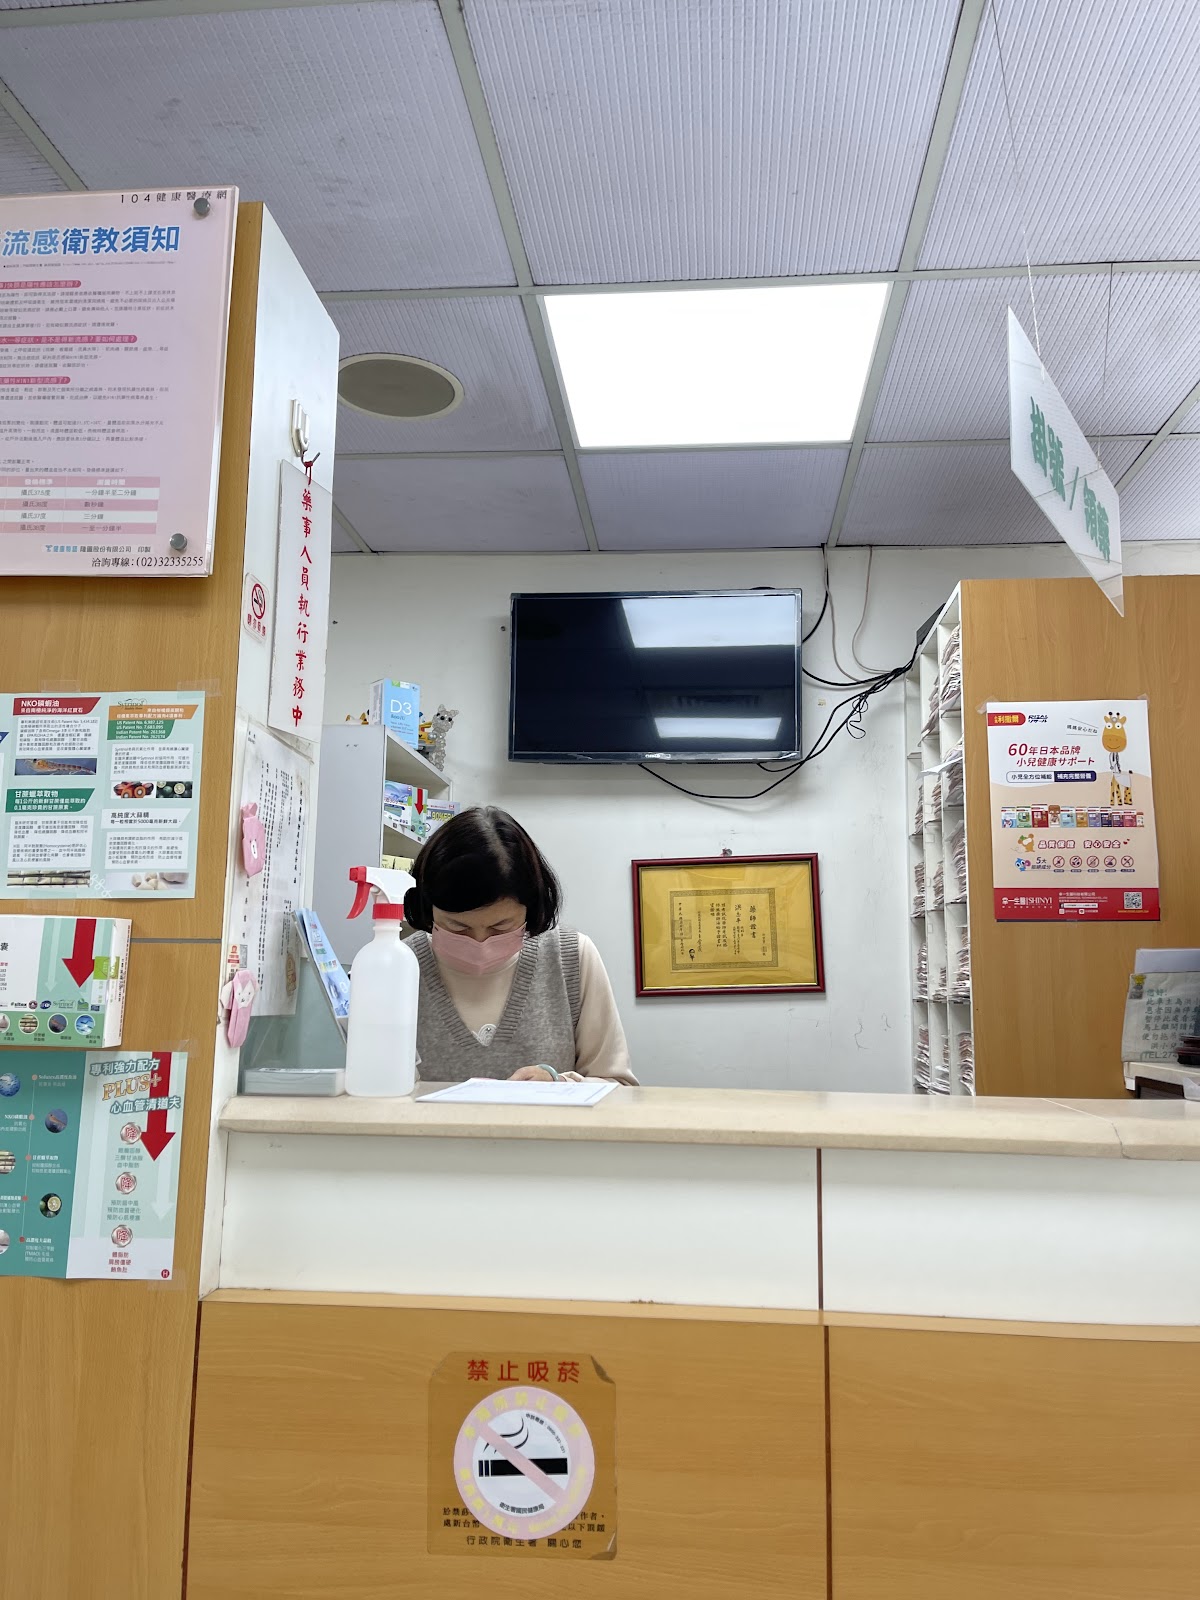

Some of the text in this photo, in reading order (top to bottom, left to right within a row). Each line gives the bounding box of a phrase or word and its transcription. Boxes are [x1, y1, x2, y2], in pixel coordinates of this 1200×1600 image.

[1, 225, 181, 256] 流感衛教須知
[292, 488, 313, 727] 藥事人員執行業務中
[390, 699, 412, 715] D3
[1008, 743, 1081, 757] 60年日本品牌
[1016, 756, 1095, 768] 小兒健康サポート
[1037, 839, 1121, 850] 品質保證 安心安全
[1028, 896, 1053, 904] SHINYI
[90, 1057, 161, 1076] 專利強力配方
[102, 1072, 162, 1102] PLUS+
[110, 1096, 182, 1114] 心血管清道夫
[126, 1126, 138, 1140] 降
[121, 1176, 134, 1191] 降
[116, 1230, 129, 1242] 降
[467, 1359, 580, 1384] 禁止吸菸
[443, 1507, 474, 1516] 於禁菸
[466, 1535, 582, 1549] 行政院衛生署 關心您
